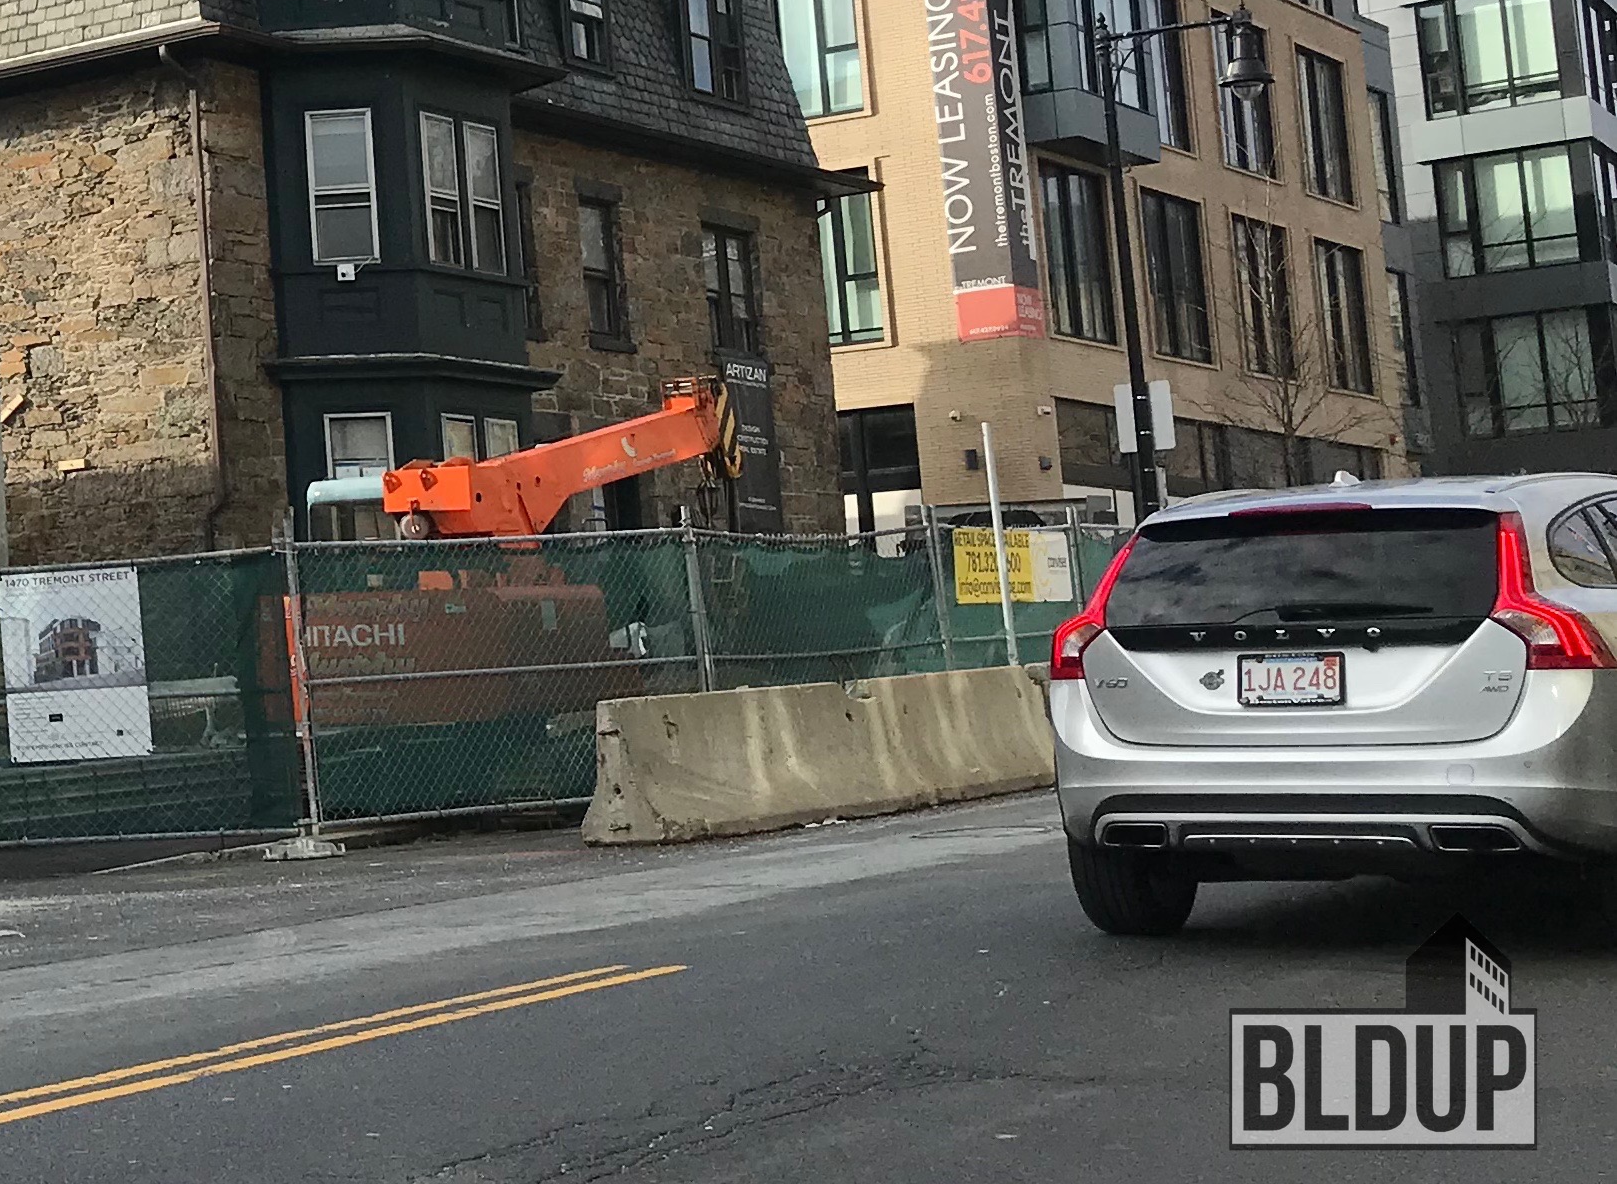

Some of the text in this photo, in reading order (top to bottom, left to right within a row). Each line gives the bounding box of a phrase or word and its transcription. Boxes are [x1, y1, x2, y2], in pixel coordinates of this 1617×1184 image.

[984, 93, 1009, 248] thetremontboston.com
[940, 157, 977, 254] NOW
[725, 362, 768, 382] ARTIZAN
[954, 531, 977, 547] RETAIL
[1003, 533, 1030, 548] AILABLE
[4, 571, 130, 588] 1470 TREMONT STREET
[1189, 627, 1381, 642] VOLVO
[1243, 666, 1337, 692] 1JA 248
[1480, 685, 1510, 693] AWD
